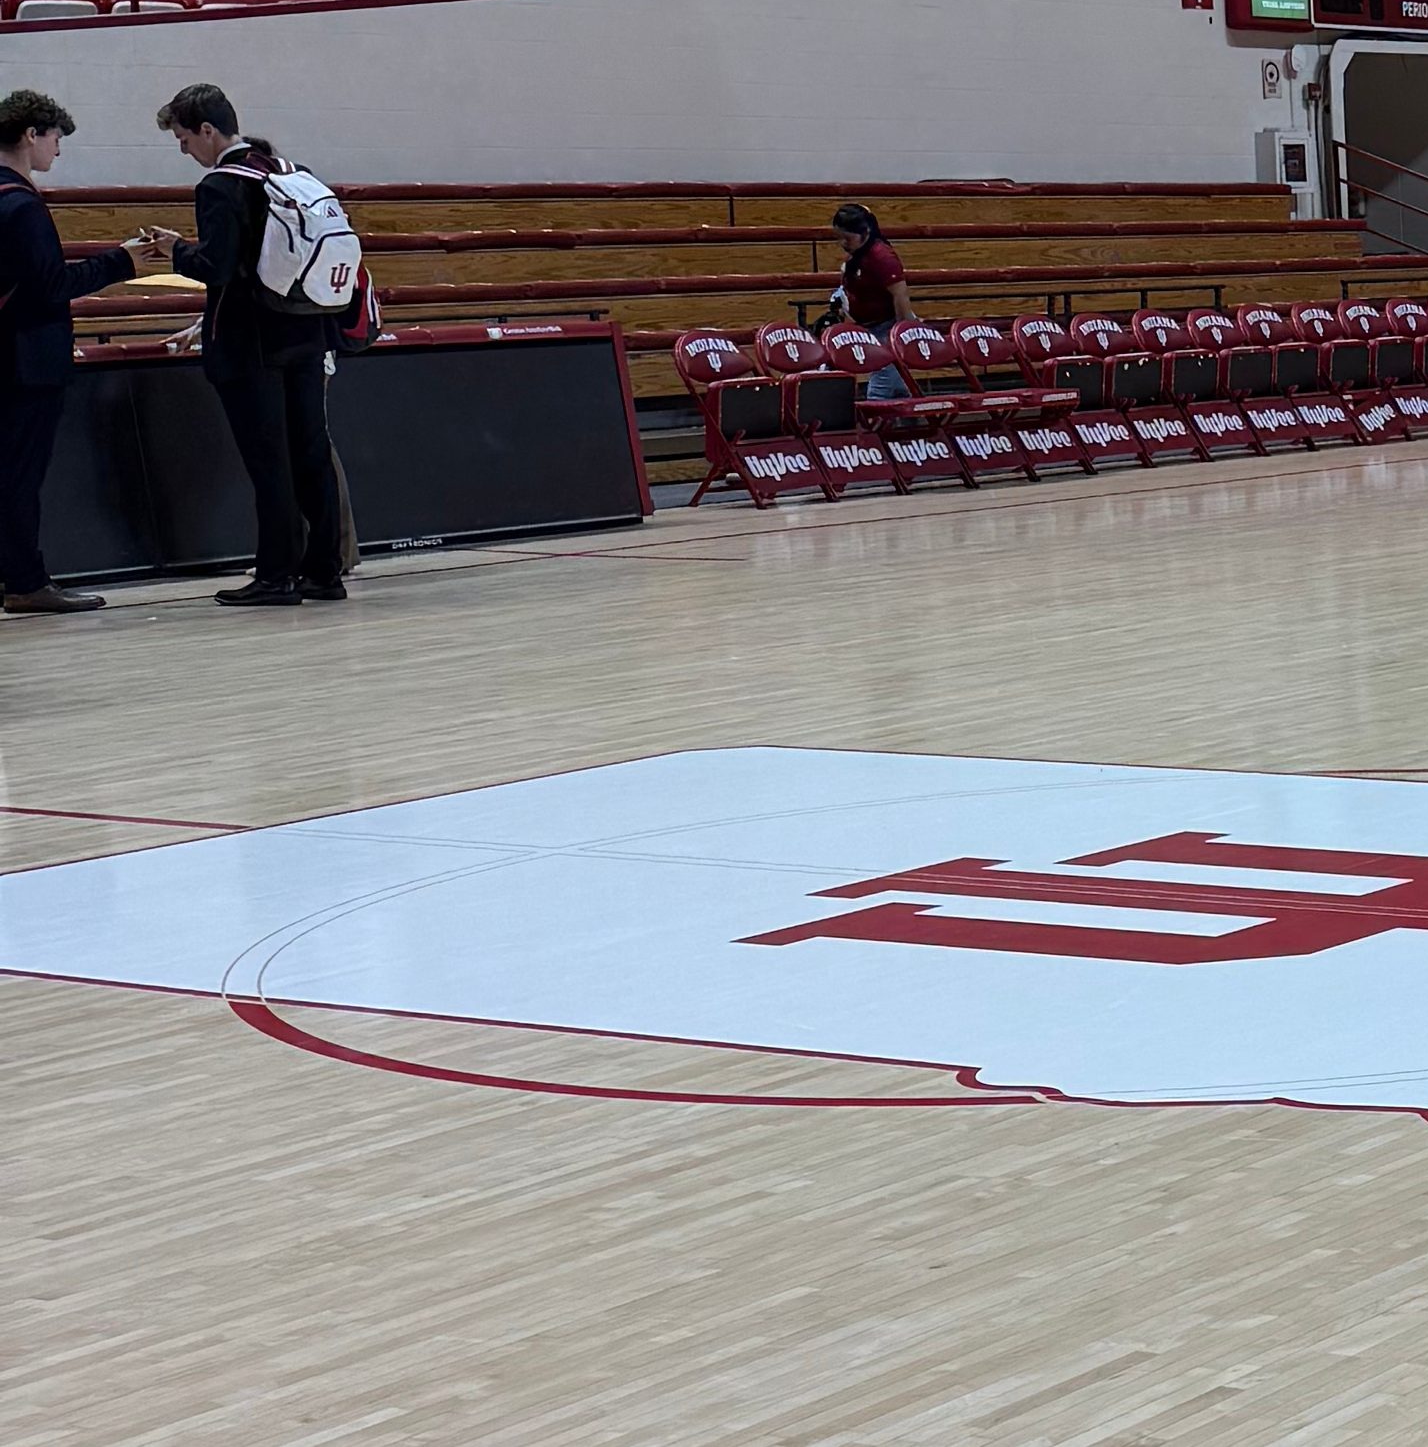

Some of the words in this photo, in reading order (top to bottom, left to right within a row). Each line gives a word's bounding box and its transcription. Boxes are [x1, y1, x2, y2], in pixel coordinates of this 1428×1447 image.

[960, 325, 1003, 342] INDIANA
[1022, 320, 1065, 337] INDIANA
[1079, 319, 1123, 336] INDIANA
[1141, 316, 1180, 332] INDIANA
[1196, 315, 1234, 331] INDIANA
[766, 327, 816, 347] INDIANA
[832, 331, 882, 350] INDIANA
[900, 327, 945, 344] INDIANA
[685, 338, 740, 358] INDIANA
[1133, 418, 1186, 442] HyVee
[1194, 412, 1244, 437] HyVee
[1247, 408, 1296, 432] HyVee
[1018, 429, 1072, 454] HyVee
[1075, 422, 1130, 447] HyVee
[888, 438, 949, 466] HyVee
[955, 434, 1013, 460] HyVee
[745, 452, 811, 481] HyVee
[819, 445, 883, 473] HyVee
